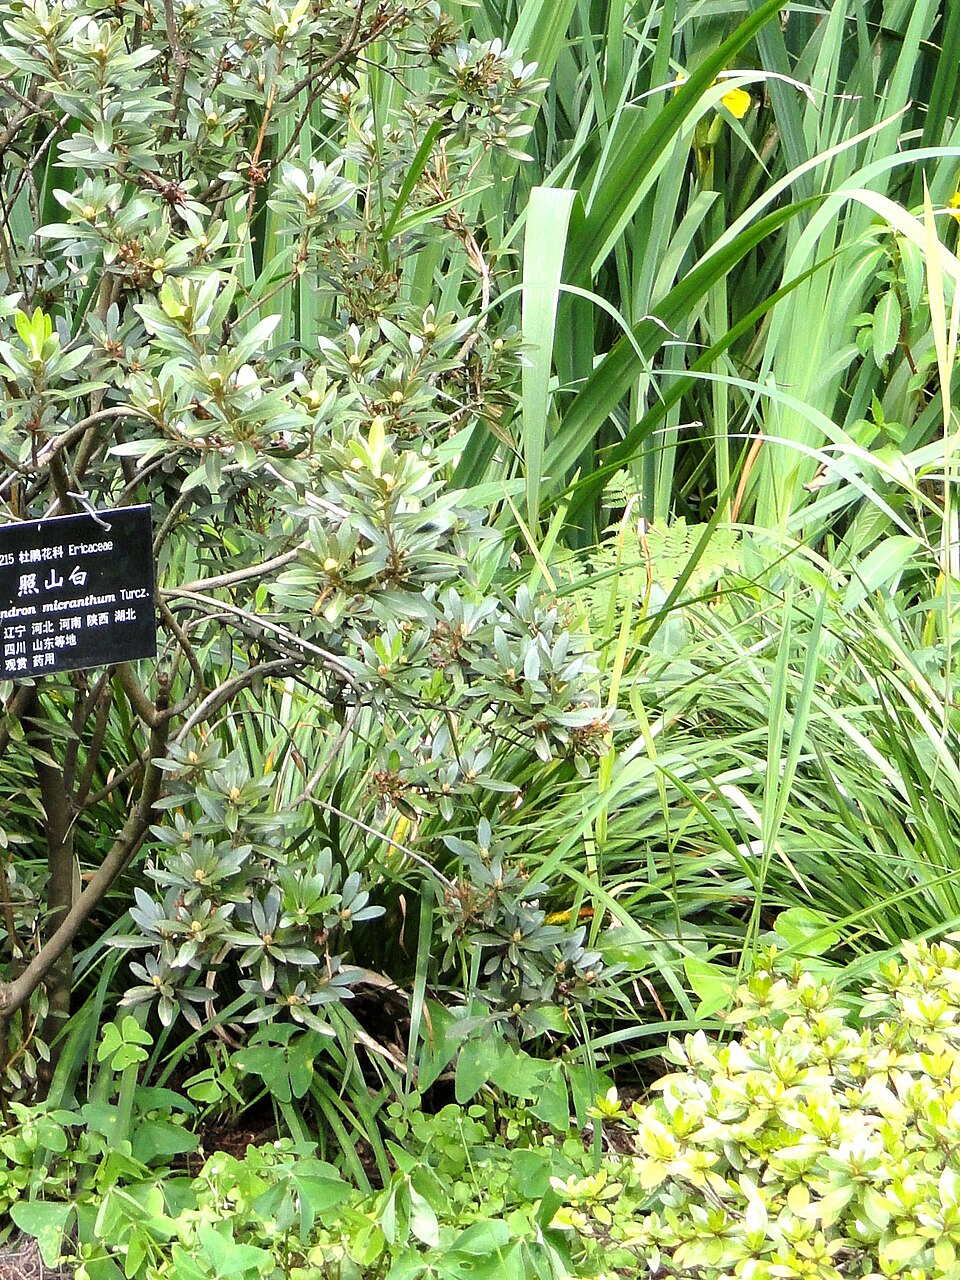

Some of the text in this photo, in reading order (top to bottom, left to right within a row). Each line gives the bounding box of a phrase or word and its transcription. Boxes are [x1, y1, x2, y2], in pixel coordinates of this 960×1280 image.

[19, 545, 64, 564] 杜鹃花科
[68, 540, 113, 556] Ericaceae
[17, 565, 88, 597] 照山白
[43, 594, 116, 613] micranthum
[120, 588, 149, 600] Turcz.
[32, 620, 54, 634] 河北
[59, 616, 82, 631] 河南
[87, 612, 109, 627] 陕西
[115, 608, 136, 622] 湖北
[5, 634, 77, 656] 四川 山东等地
[32, 653, 55, 667] 药用
